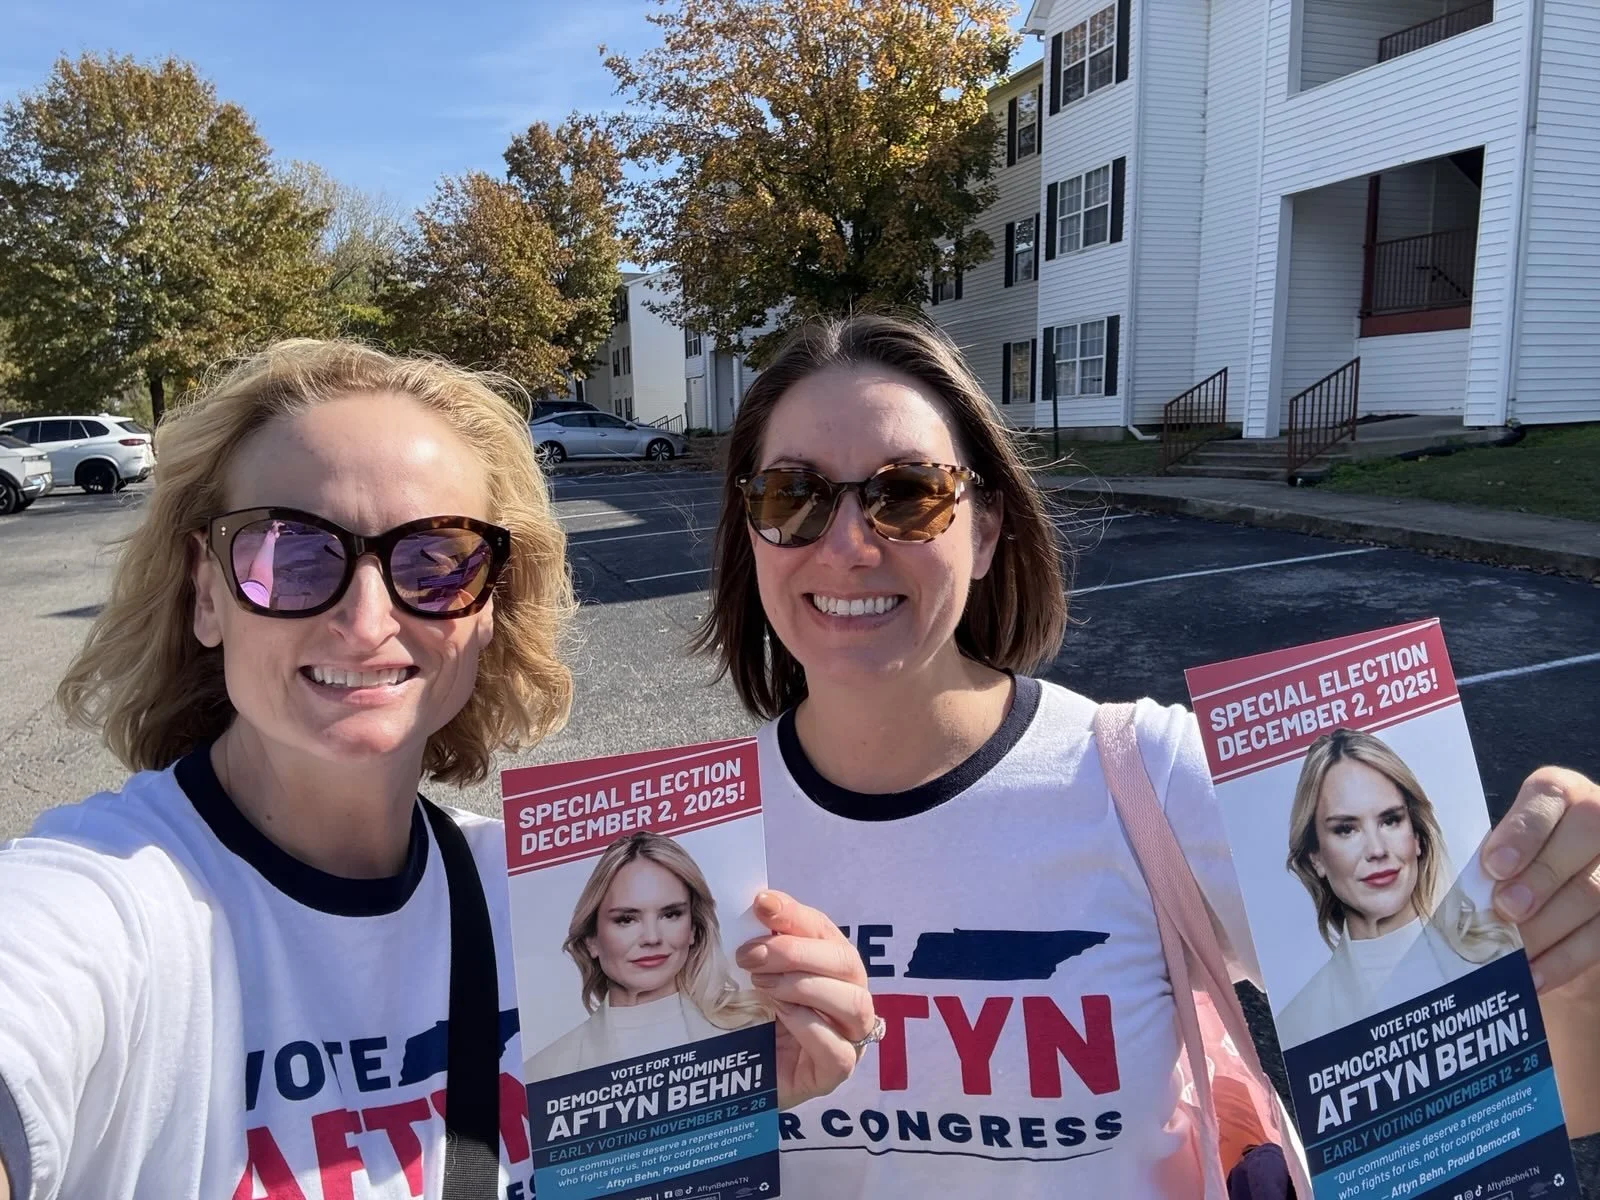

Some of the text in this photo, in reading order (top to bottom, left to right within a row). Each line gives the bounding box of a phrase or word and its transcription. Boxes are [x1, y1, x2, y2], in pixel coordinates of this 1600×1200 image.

[1210, 642, 1429, 732] SPECIAL ELECTION
[1217, 668, 1439, 761] DECEMBER 2, 2025!
[519, 758, 741, 828] SPECIAL ELECTION
[521, 781, 745, 856] DECEMBER 2, 2025!
[872, 994, 1120, 1098] TYN
[1370, 994, 1456, 1041] VOTE FOR THE
[546, 1074, 665, 1115] DEMOCRATIC
[611, 1051, 697, 1080] VOTE FOR THE
[1308, 1031, 1429, 1095] DEMOCRATIC
[1317, 1008, 1529, 1134] AFTYN BEHN!
[547, 1064, 762, 1142] AFTYN BEHN!
[549, 1142, 595, 1162] EARLY
[598, 1129, 647, 1151] VOTING
[650, 1109, 723, 1137] NOVEMBER
[726, 1105, 739, 1118] 12
[751, 1098, 766, 1111] 26
[821, 1109, 1122, 1148] CONGRESS
[1323, 1131, 1369, 1165] EARLY
[1373, 1108, 1423, 1142] VOTING
[1425, 1073, 1497, 1119] NOVEMBER
[1499, 1066, 1512, 1083] 12
[1523, 1054, 1539, 1072] 26
[1358, 1140, 1421, 1176] communities
[1422, 1122, 1459, 1146] deserve
[1460, 1119, 1466, 1128] a
[1468, 1087, 1532, 1123] representative
[558, 1177, 578, 1187] who
[580, 1170, 609, 1184] fights
[610, 1166, 623, 1175] for
[641, 1158, 657, 1168] not
[660, 1152, 673, 1161] for
[673, 1141, 720, 1158] corporate
[579, 1151, 640, 1172] communities
[642, 1141, 679, 1156] deserve
[688, 1121, 755, 1145] representative
[606, 1177, 633, 1190] Aftyn
[663, 1161, 691, 1175] Proud
[692, 1148, 738, 1167] Democrat
[1338, 1185, 1360, 1200] who
[1361, 1171, 1391, 1190] fights
[1392, 1164, 1406, 1176] for
[1423, 1147, 1439, 1162] not
[1441, 1139, 1457, 1152] for
[1455, 1118, 1499, 1146] corporate
[1391, 1179, 1418, 1199] Aftyn
[1447, 1149, 1475, 1171] Proud
[1476, 1127, 1521, 1156] Democrat
